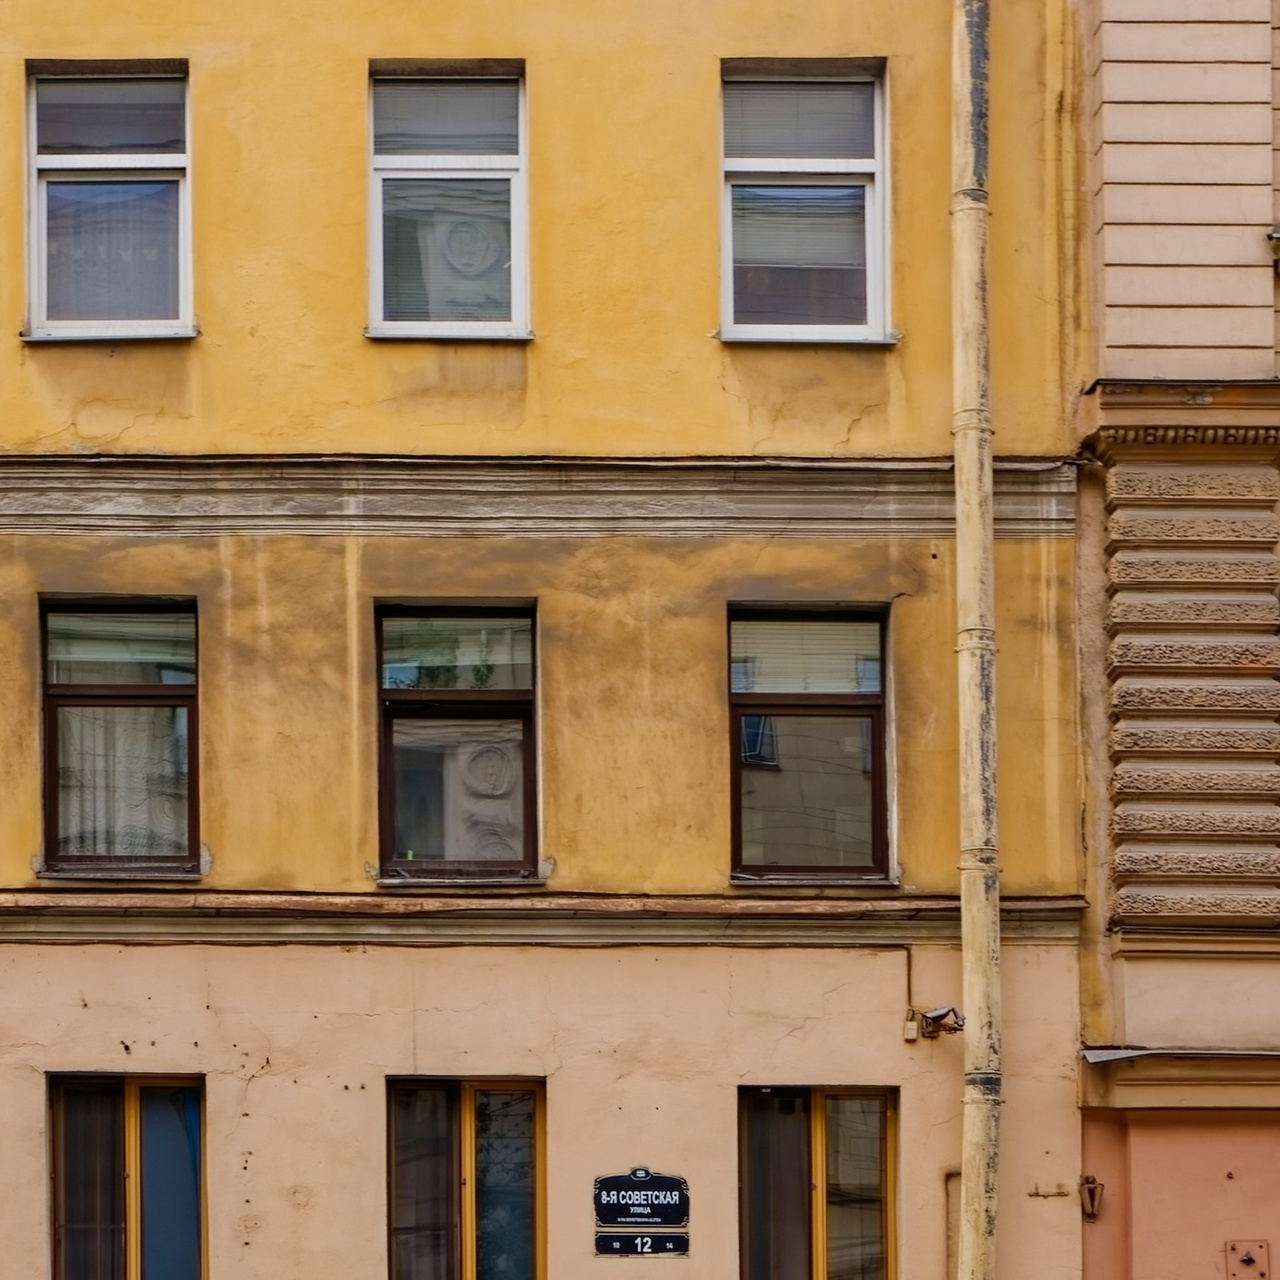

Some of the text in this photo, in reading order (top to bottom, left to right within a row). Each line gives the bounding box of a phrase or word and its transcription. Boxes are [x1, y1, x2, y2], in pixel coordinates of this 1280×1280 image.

[601, 1191, 680, 1204] 8-Я СОВЕТСКАЯ
[629, 1206, 652, 1214] УЛИЦА
[634, 1237, 652, 1253] 12
